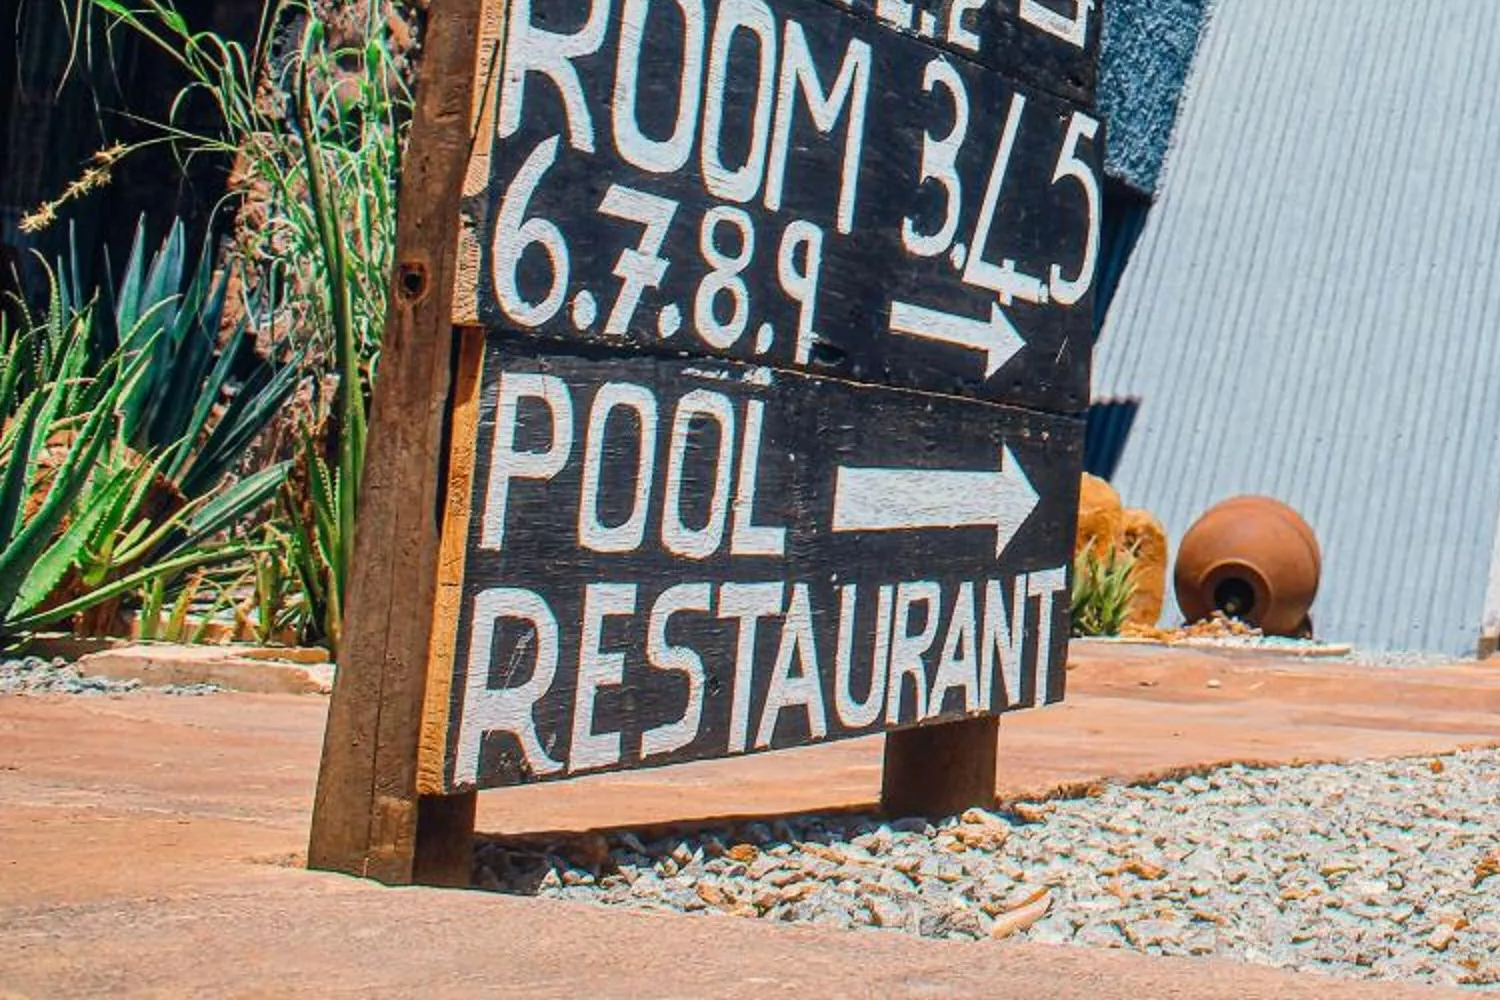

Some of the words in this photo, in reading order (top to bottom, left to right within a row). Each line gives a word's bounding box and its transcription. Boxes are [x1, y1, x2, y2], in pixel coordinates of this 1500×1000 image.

[493, 135, 823, 365] 6.7.8.9
[478, 370, 786, 560] POOL
[453, 565, 1067, 788] RESTAURANT
